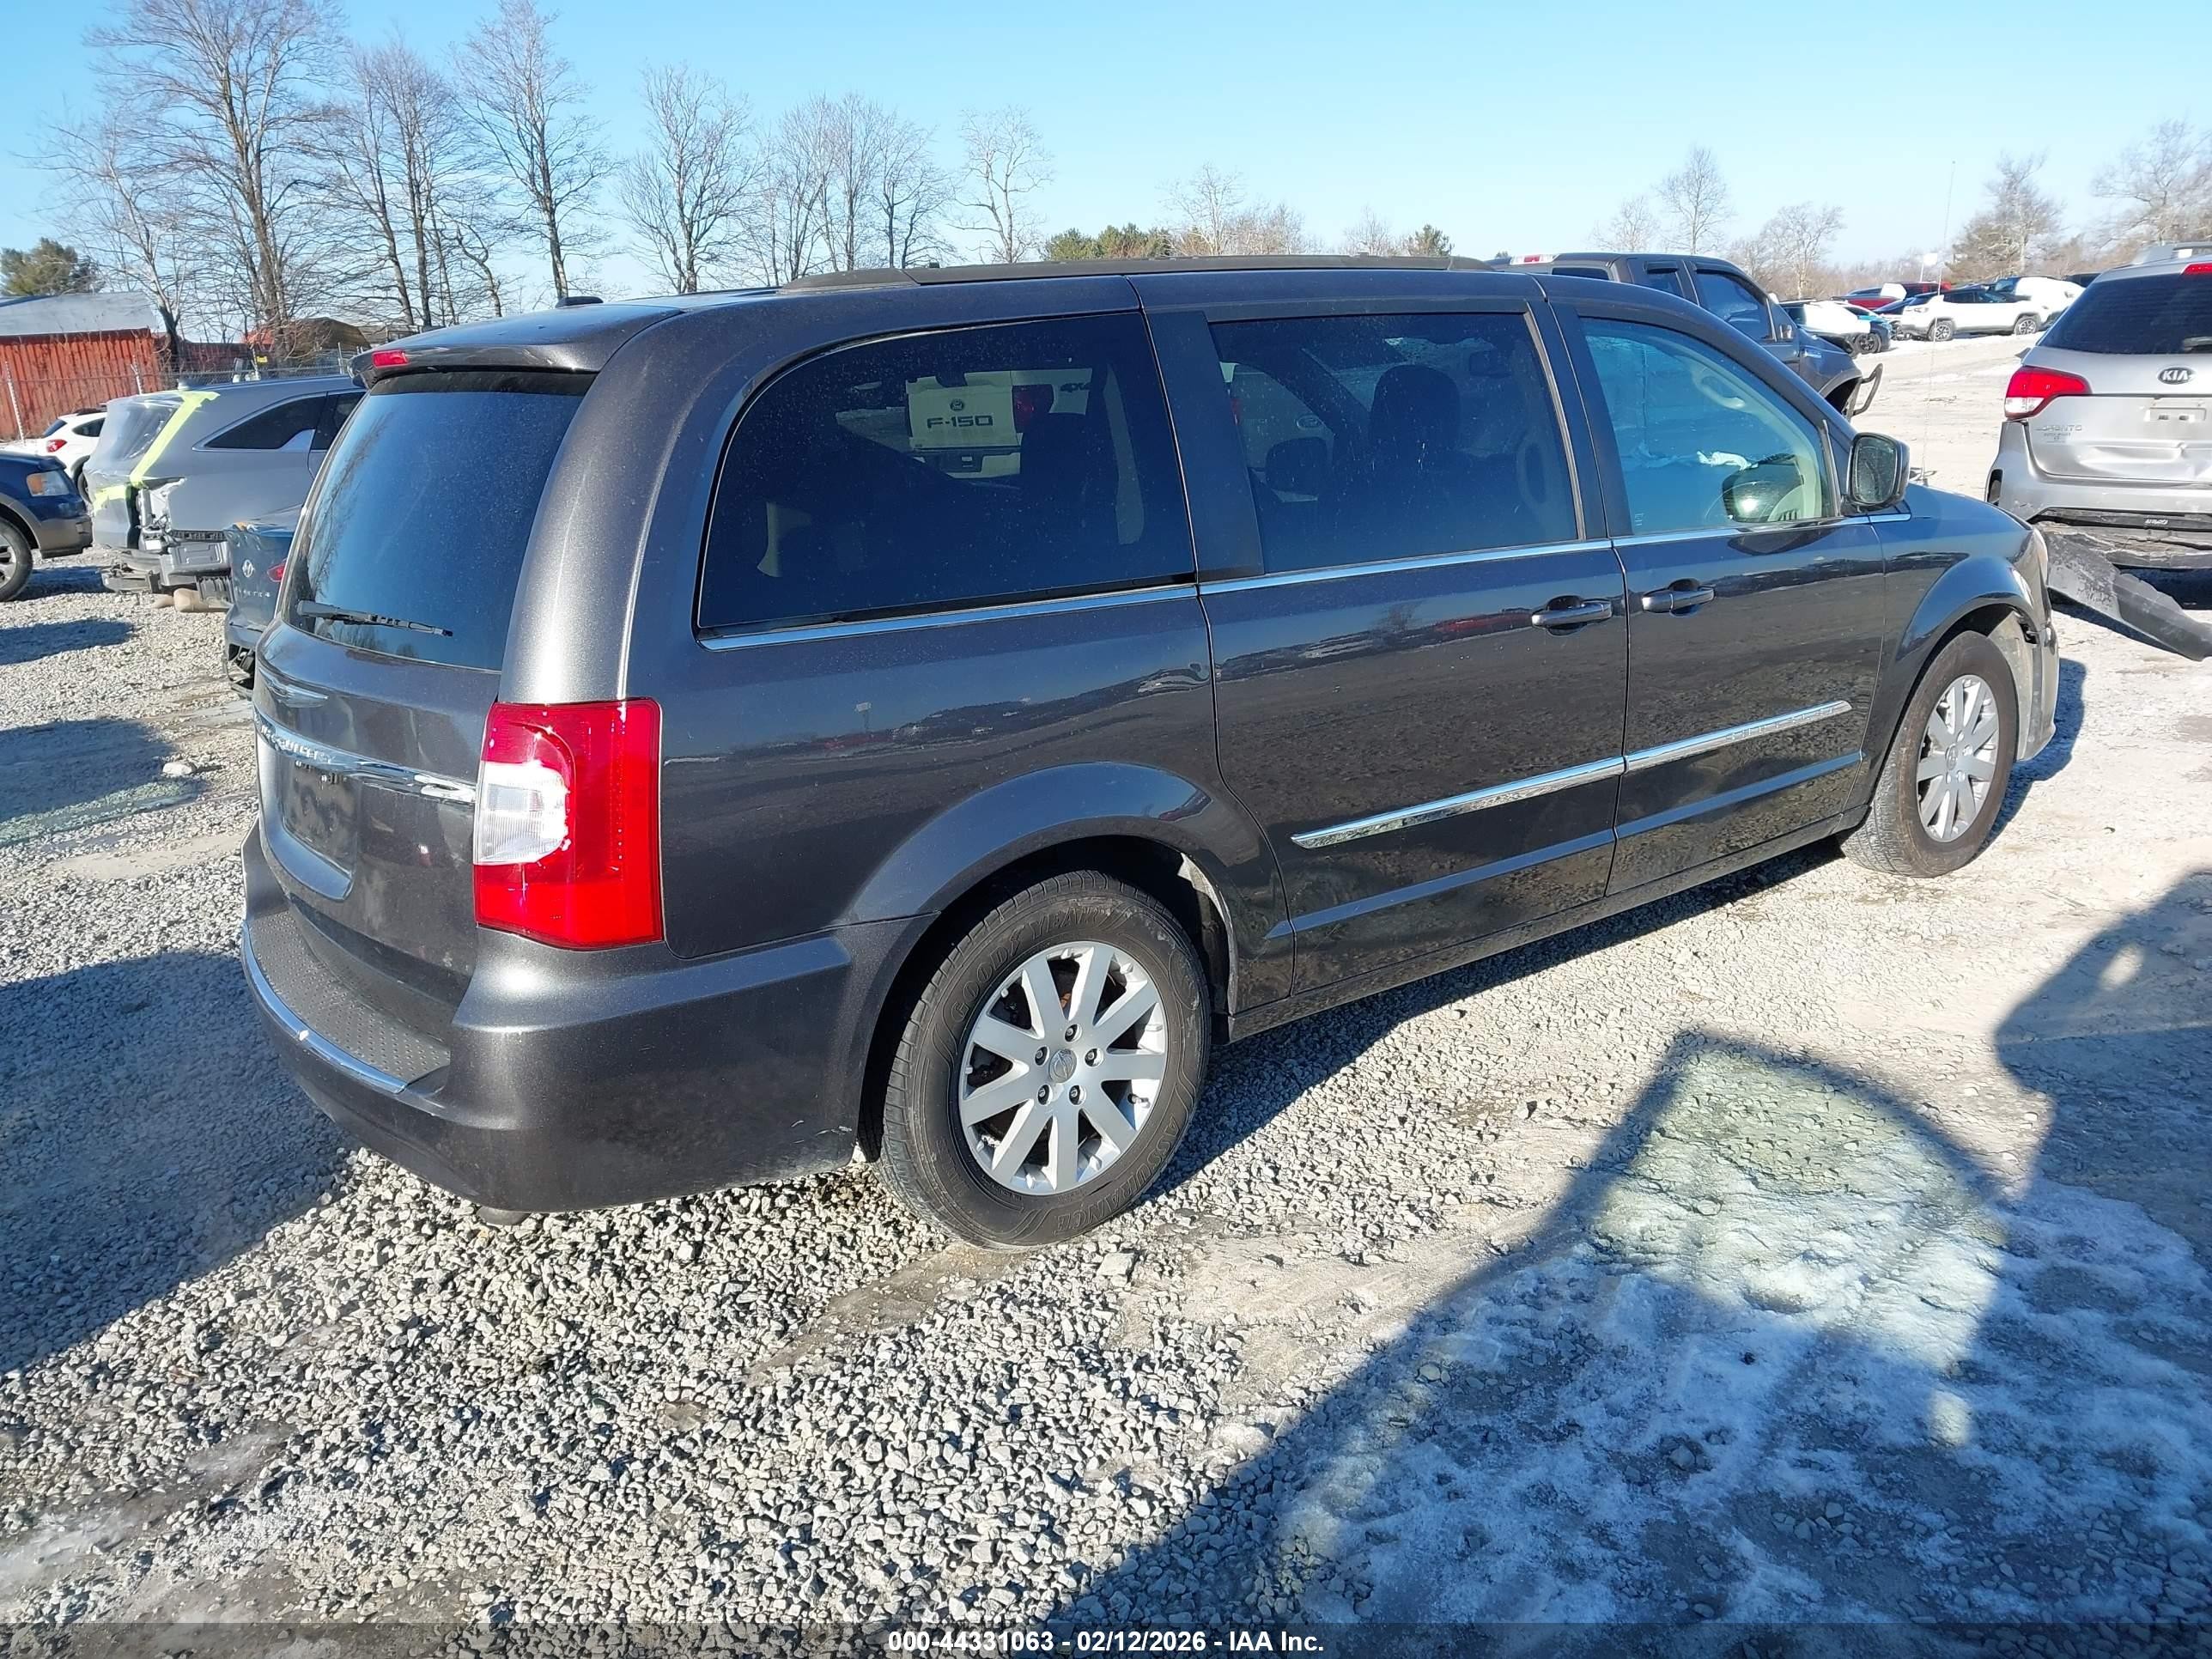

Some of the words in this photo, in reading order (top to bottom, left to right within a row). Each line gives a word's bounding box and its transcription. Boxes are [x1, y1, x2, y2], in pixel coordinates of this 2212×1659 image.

[2161, 369, 2189, 380] KIA
[927, 415, 994, 429] F-150
[1056, 1112, 1181, 1231] ASSURANCE
